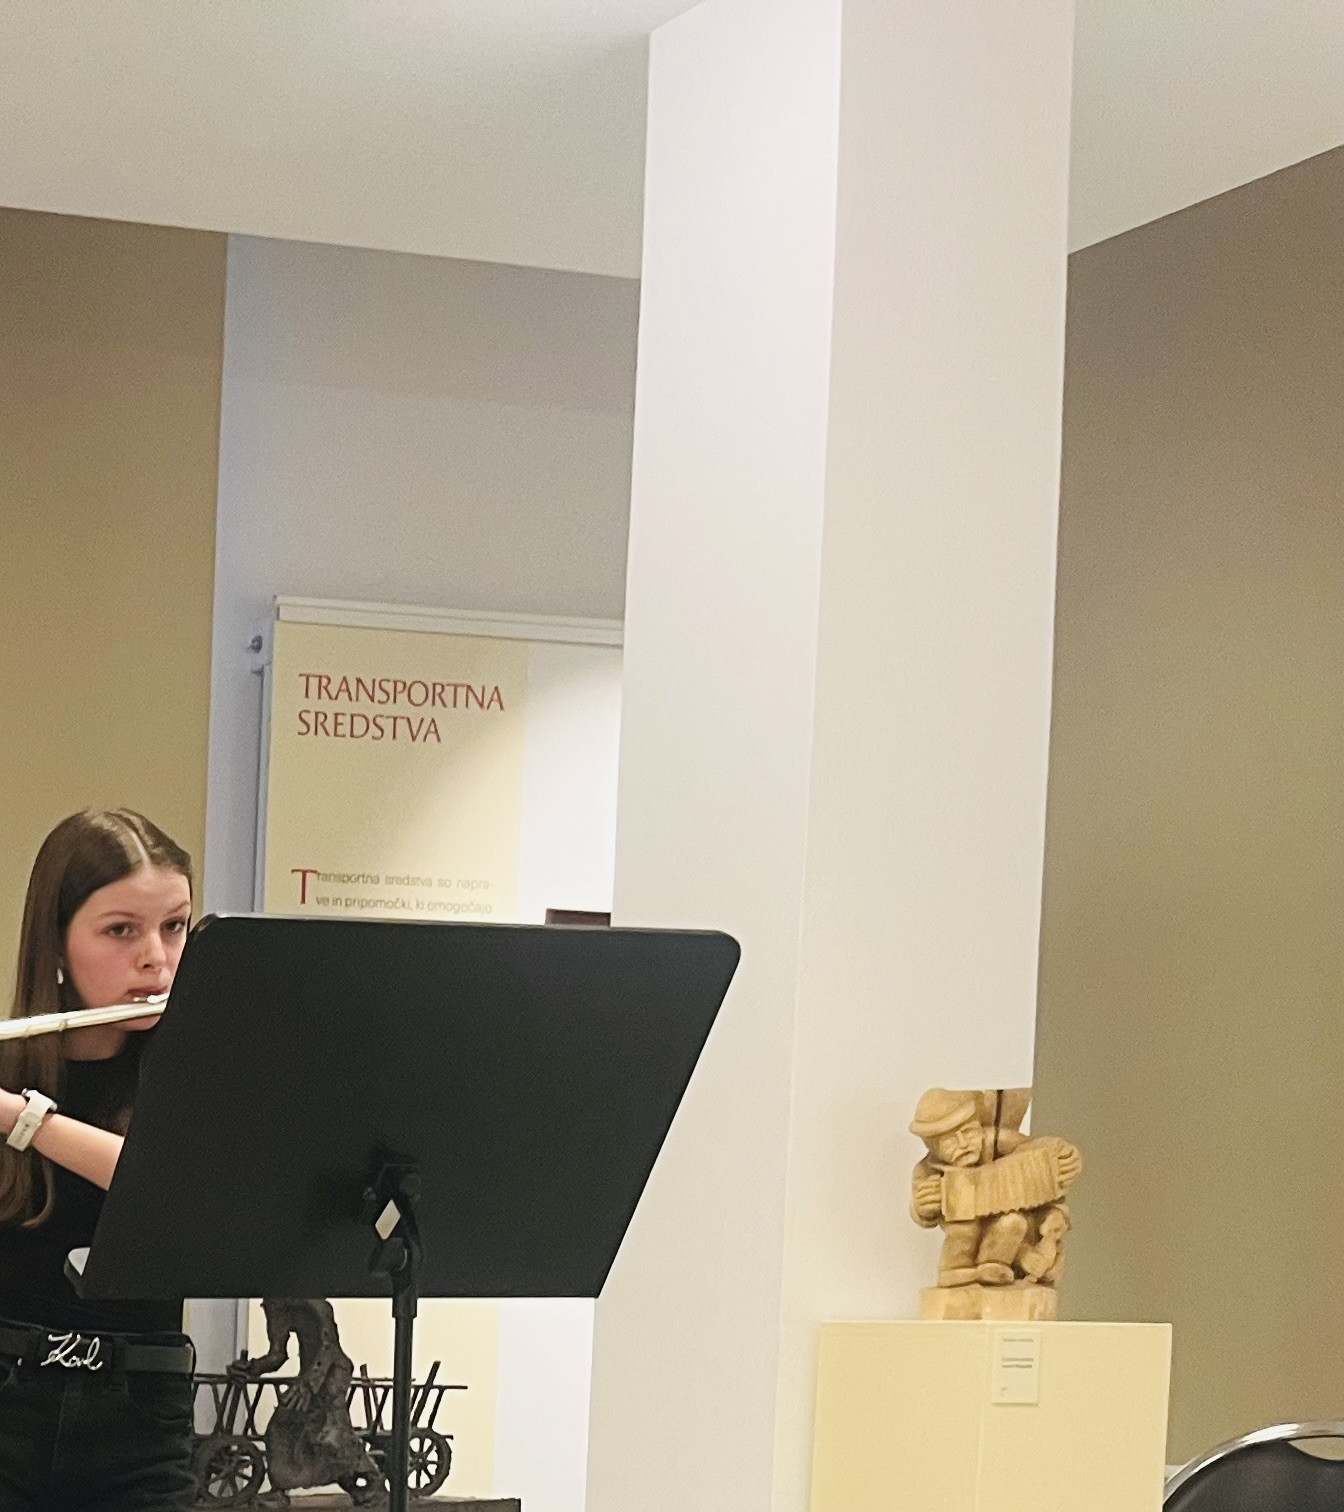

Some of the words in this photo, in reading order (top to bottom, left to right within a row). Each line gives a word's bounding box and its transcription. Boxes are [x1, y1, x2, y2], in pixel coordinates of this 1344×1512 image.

[298, 673, 505, 712] TRANSPORTNA
[296, 710, 441, 744] SREDSTVA
[385, 873, 433, 888] sredstva
[437, 878, 452, 889] so
